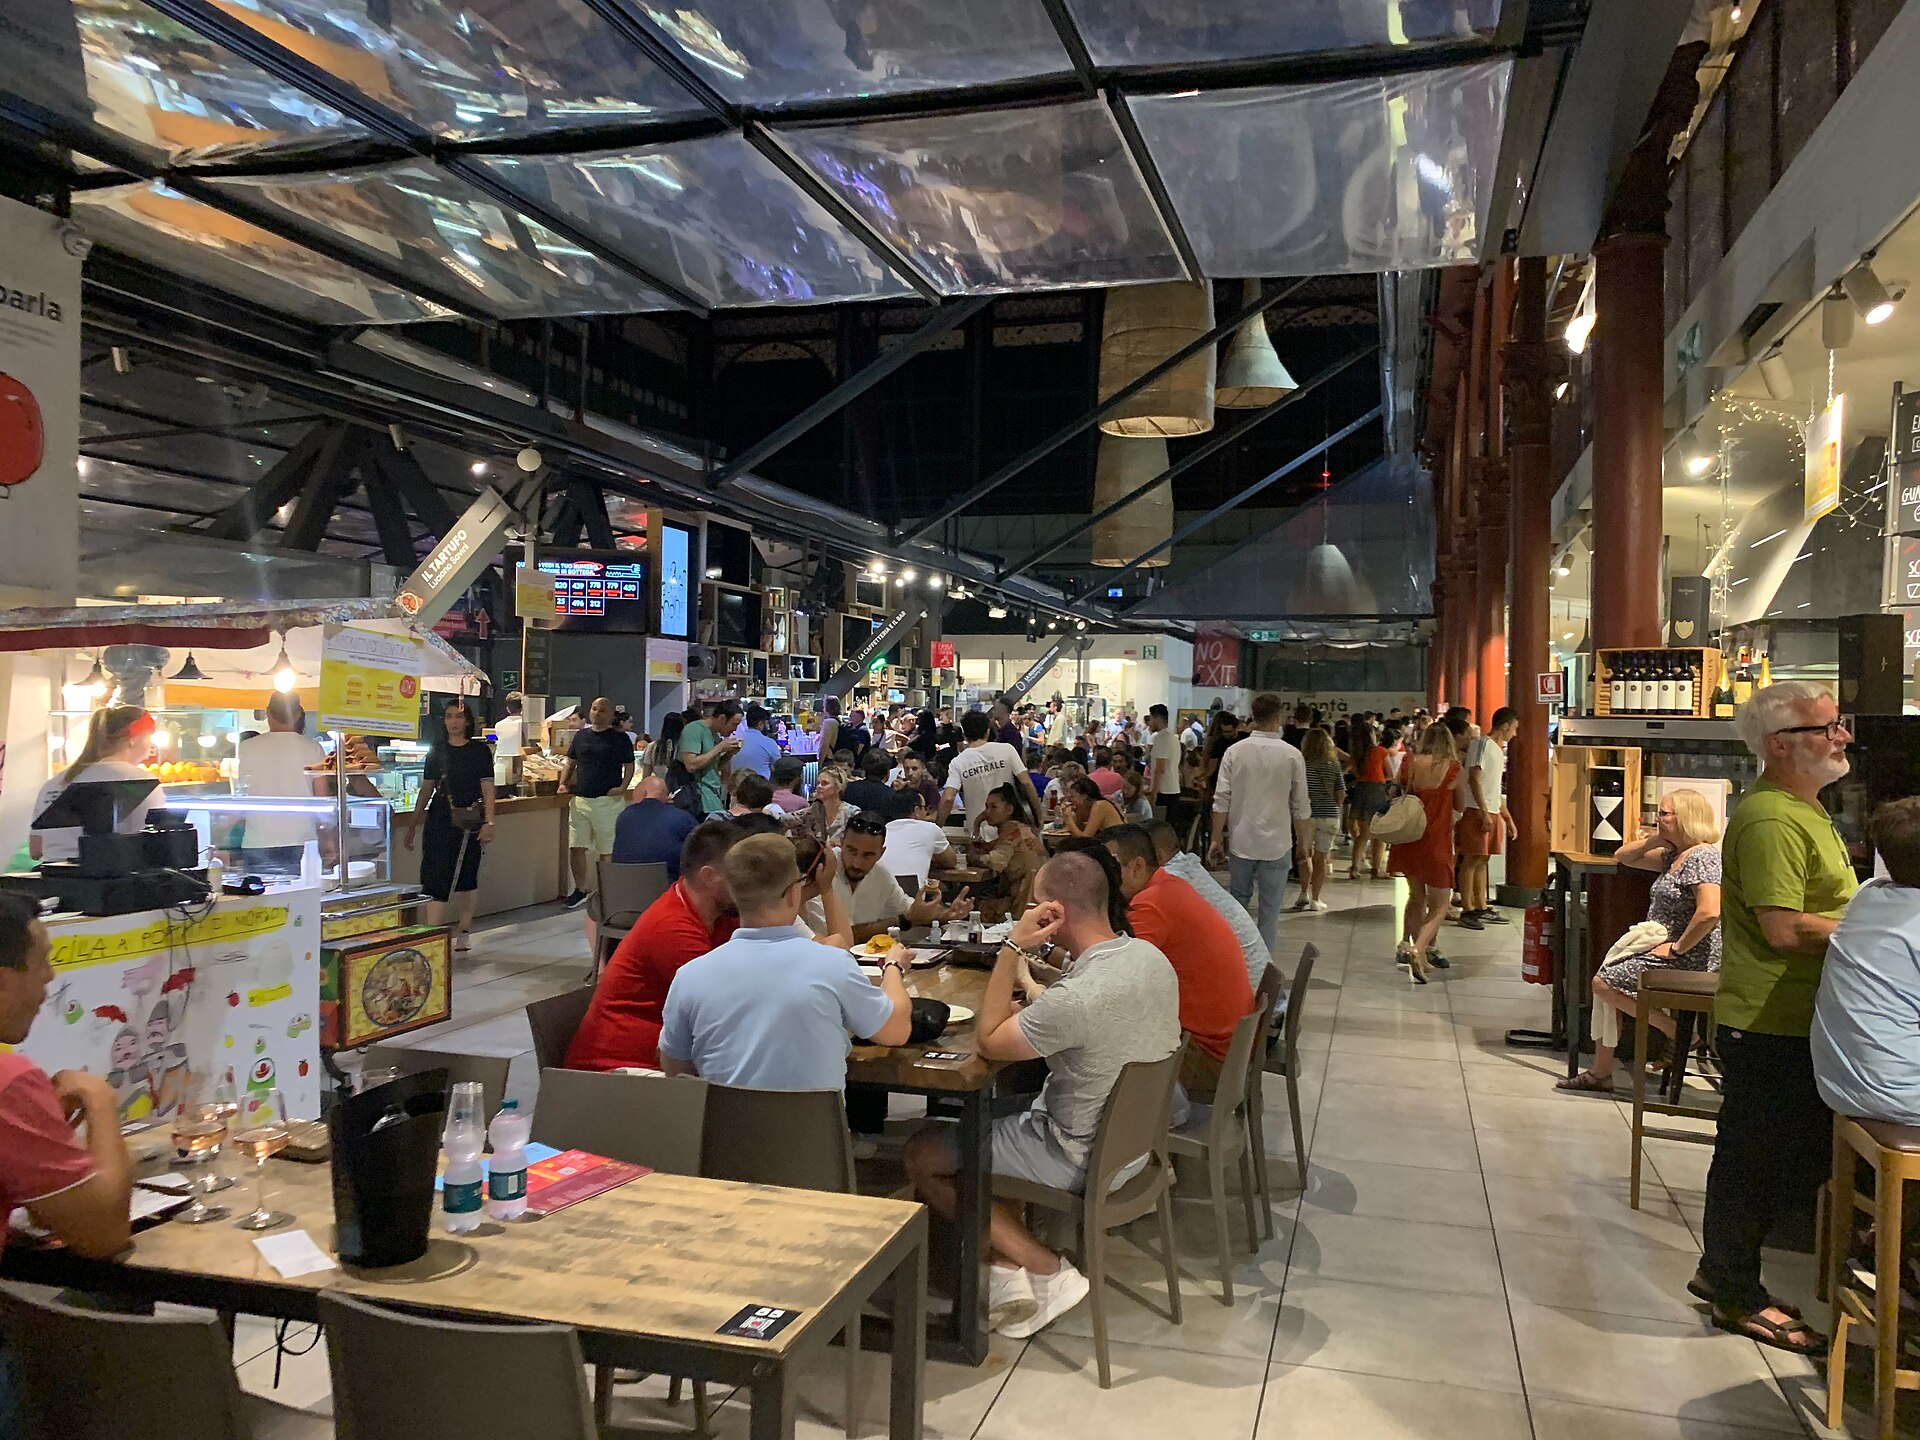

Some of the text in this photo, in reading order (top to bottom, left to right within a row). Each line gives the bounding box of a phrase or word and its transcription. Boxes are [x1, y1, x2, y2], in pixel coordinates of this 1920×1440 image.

[421, 529, 467, 583] IL TARTUFO
[428, 563, 453, 589] Luciano
[449, 542, 470, 565] Savini
[858, 653, 865, 661] LA
[1196, 640, 1224, 661] NO
[962, 759, 1006, 779] CENTRALE
